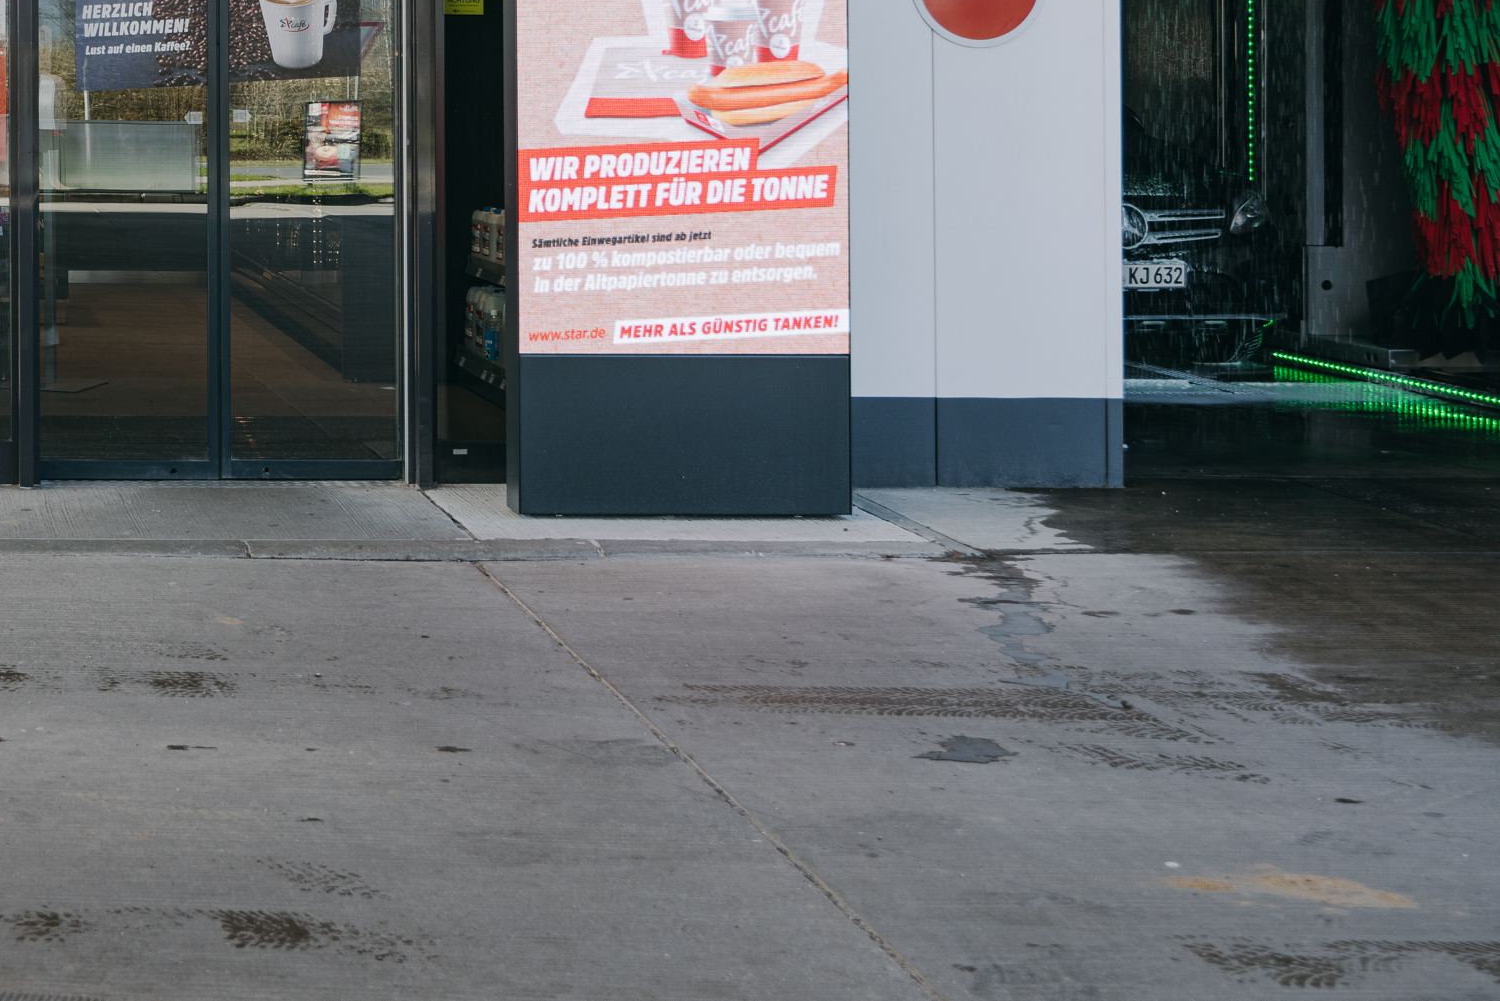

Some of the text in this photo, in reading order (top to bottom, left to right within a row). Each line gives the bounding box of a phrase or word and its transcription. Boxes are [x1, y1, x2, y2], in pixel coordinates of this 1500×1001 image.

[81, 1, 153, 20] HERZLICH
[83, 18, 190, 38] WILLKOMMEN!
[85, 41, 191, 56] Lust auf einen Kaffee?
[529, 147, 751, 182] WIR PRODUZIEREN
[528, 174, 830, 213] KOMPLETT FÜR DIE TONNE
[531, 231, 712, 248] Sämtliche Einwegartikel sind ab jetzt
[533, 241, 841, 272] zu 100 % kompostierbar oder bequem
[534, 265, 818, 295] in der Altpapiertonne zu entsorgen.
[1128, 267, 1183, 285] KJ 632
[529, 315, 839, 342] www.star.de MEHR ALS GÜNSTIG TANKEN!
